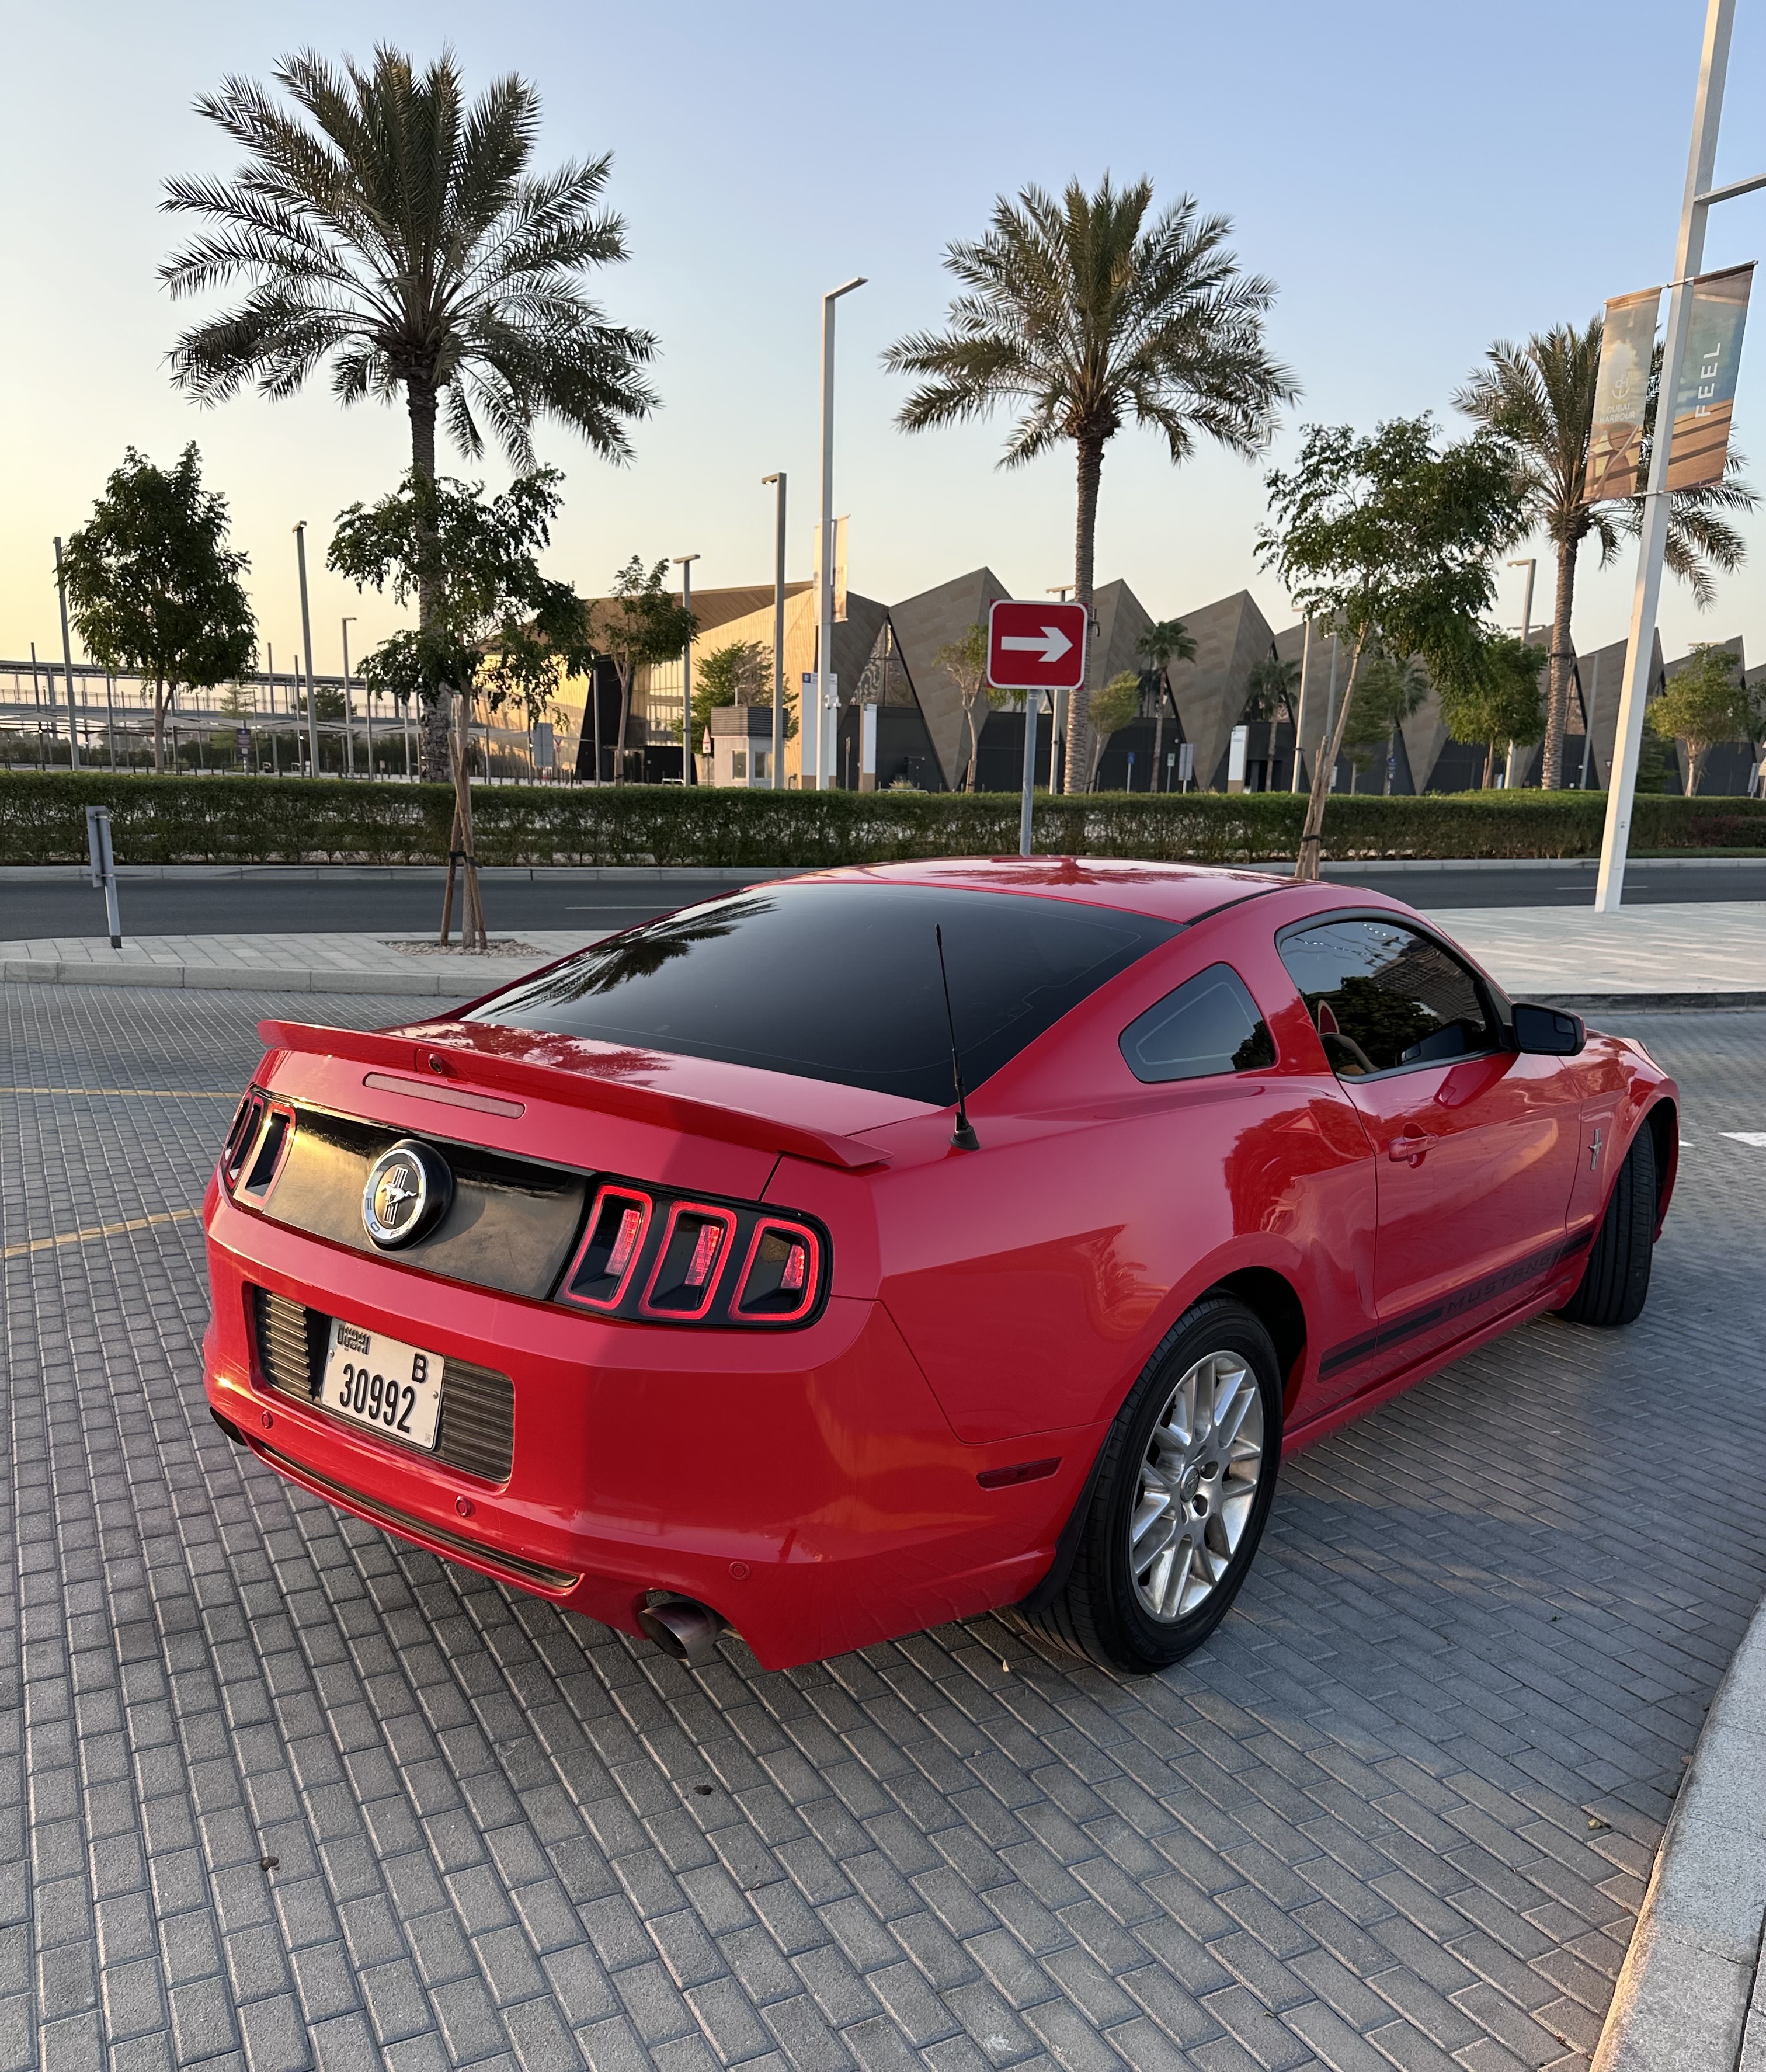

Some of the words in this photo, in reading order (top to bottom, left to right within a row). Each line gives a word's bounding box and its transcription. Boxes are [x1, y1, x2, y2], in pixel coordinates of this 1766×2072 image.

[1695, 342, 1721, 418] FEEL
[1600, 411, 1635, 423] HARBOUR
[1607, 402, 1631, 414] DUBAI
[1447, 1254, 1549, 1313] MUSTANG
[411, 1353, 428, 1383] B
[339, 1363, 415, 1434] 30992
